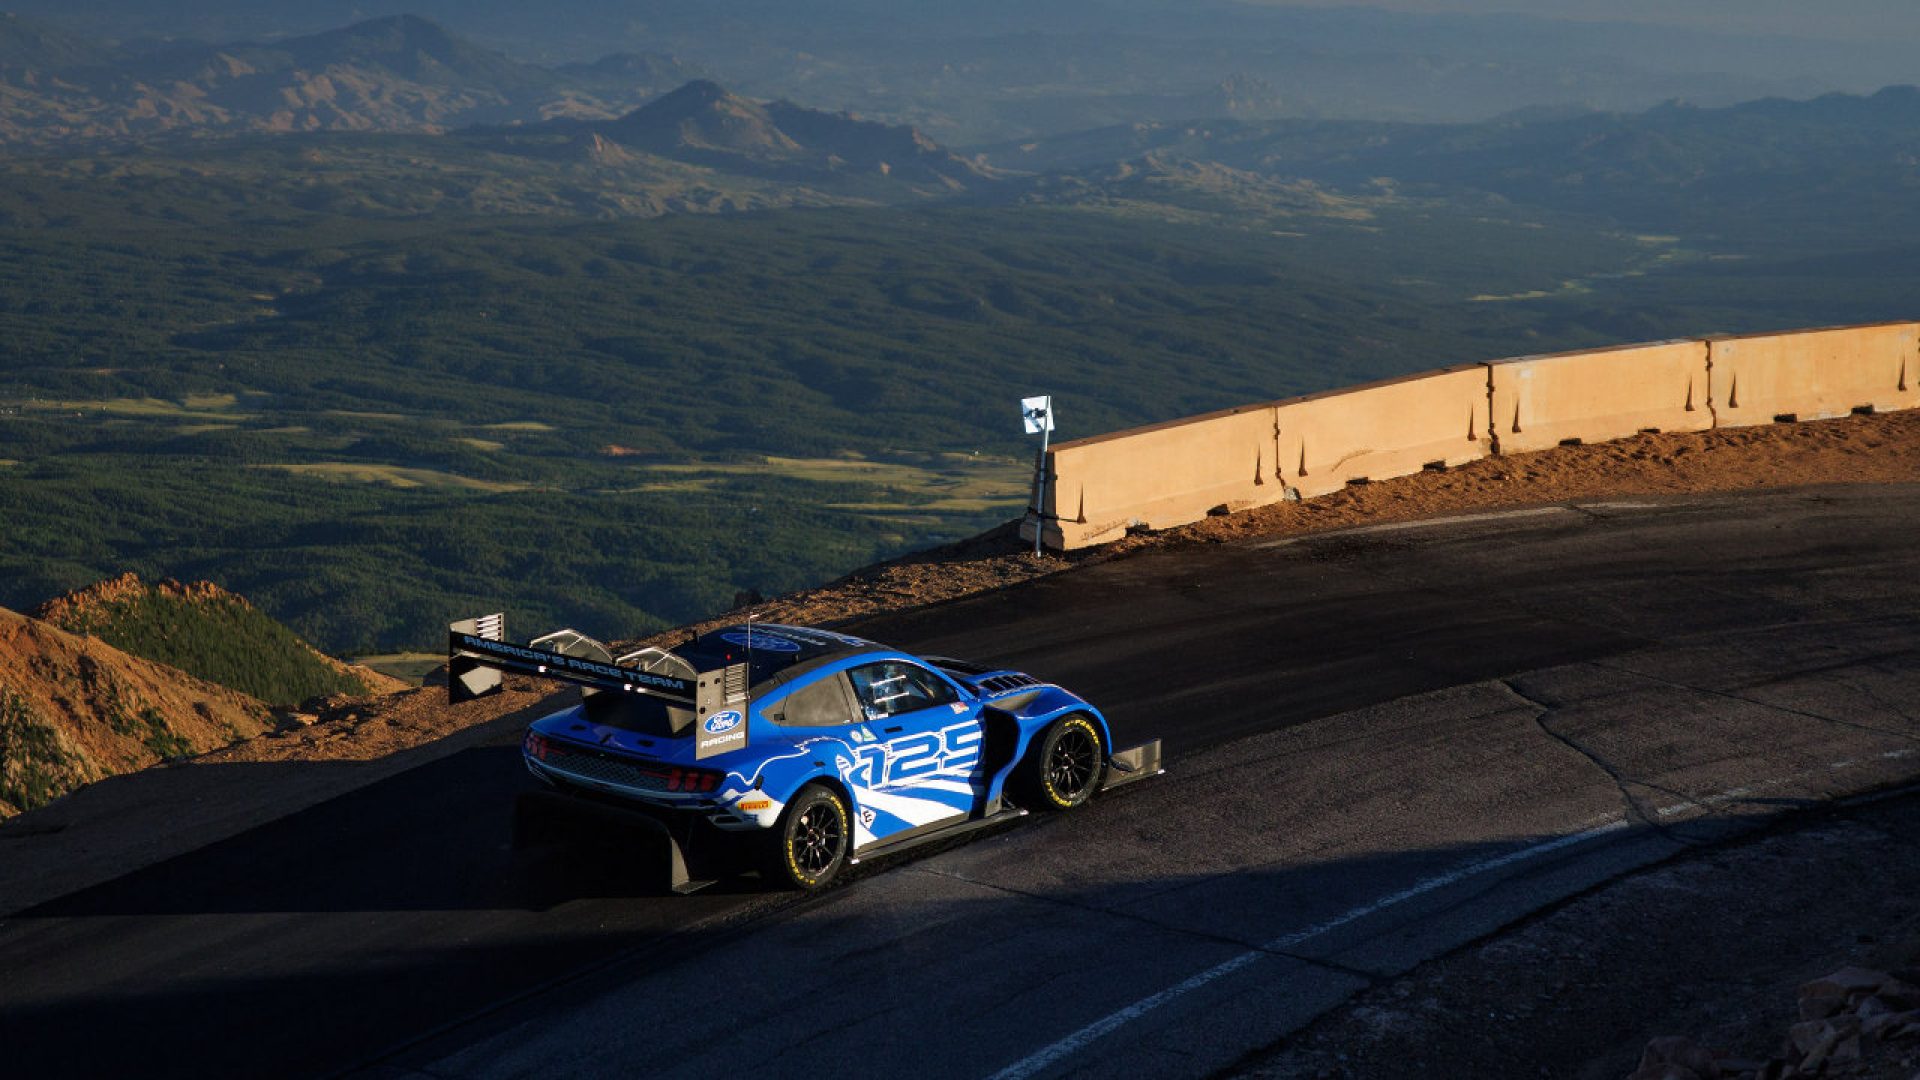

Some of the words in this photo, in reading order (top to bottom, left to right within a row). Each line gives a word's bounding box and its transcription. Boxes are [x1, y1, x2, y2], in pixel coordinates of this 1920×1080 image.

[463, 635, 564, 664] AMERICA'S
[569, 660, 621, 676] RACE
[624, 671, 684, 690] TEAM
[701, 732, 745, 748] RACING
